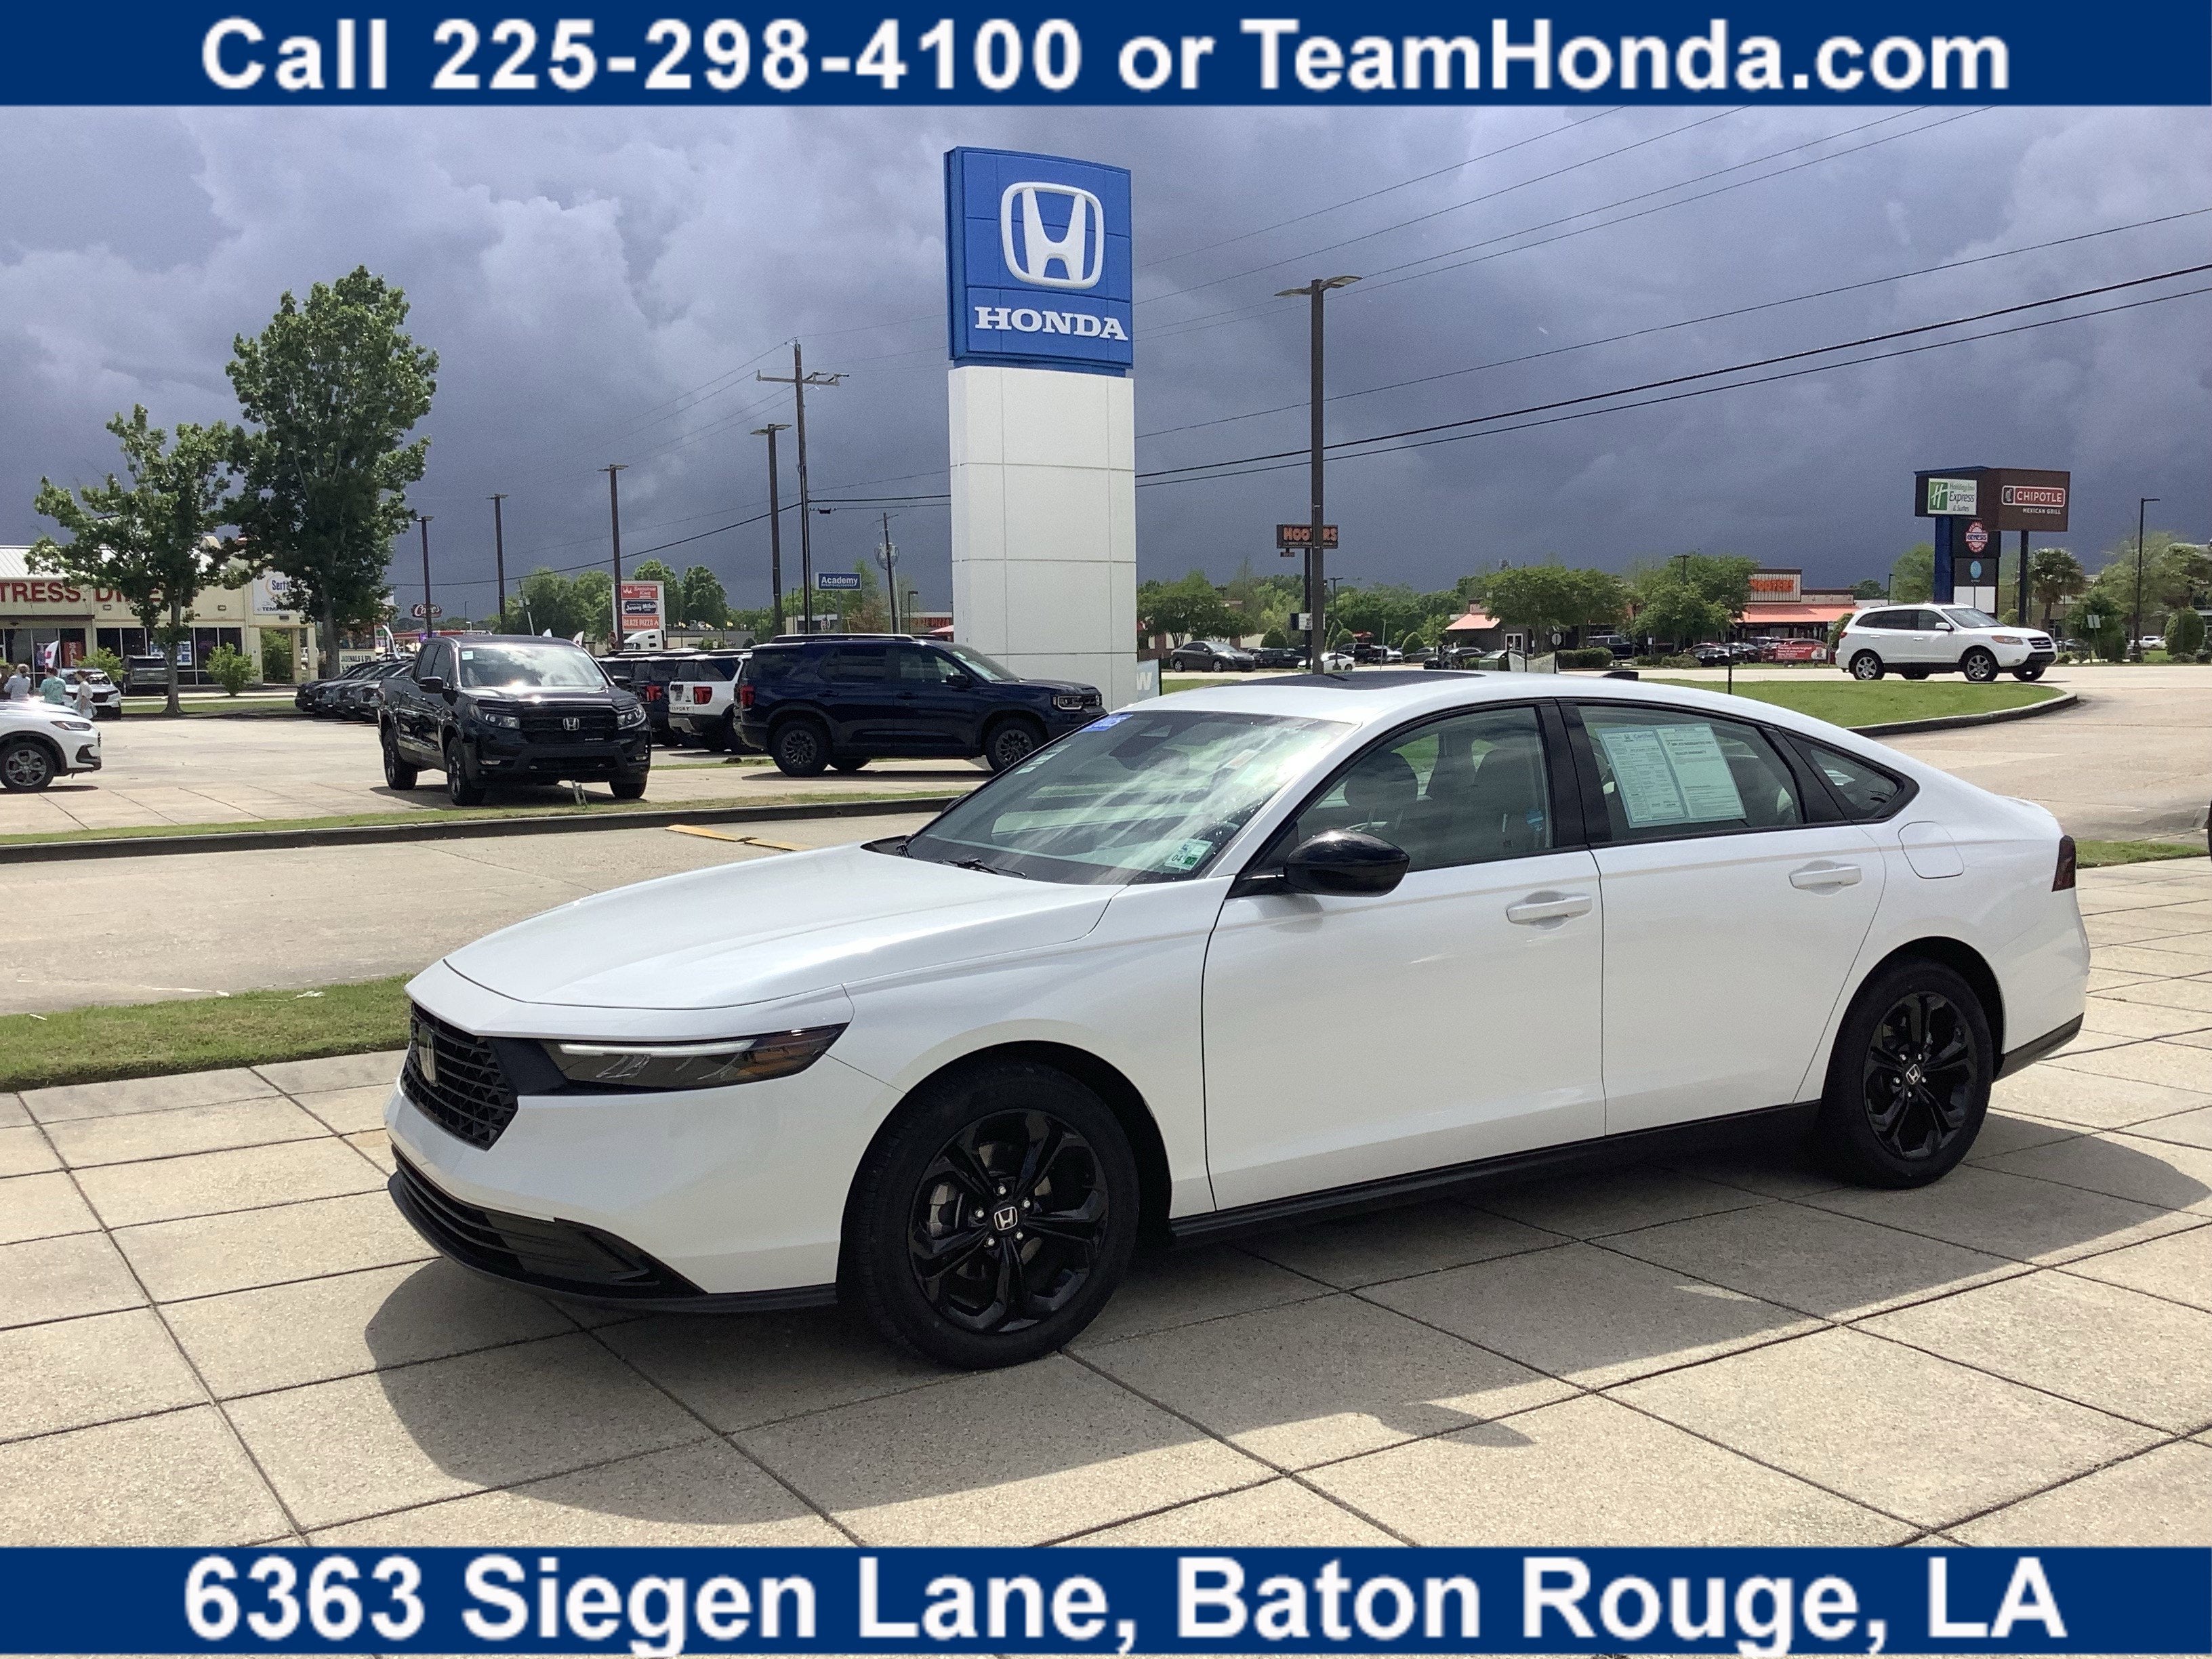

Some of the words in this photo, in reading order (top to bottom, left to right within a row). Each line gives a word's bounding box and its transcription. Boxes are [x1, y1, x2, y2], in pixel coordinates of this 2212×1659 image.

[974, 306, 1128, 341] HONDA
[1949, 491, 1975, 504] Express
[2016, 491, 2062, 502] CHIPOTLE
[1283, 527, 1337, 541] HOORS
[821, 576, 858, 586] Academy
